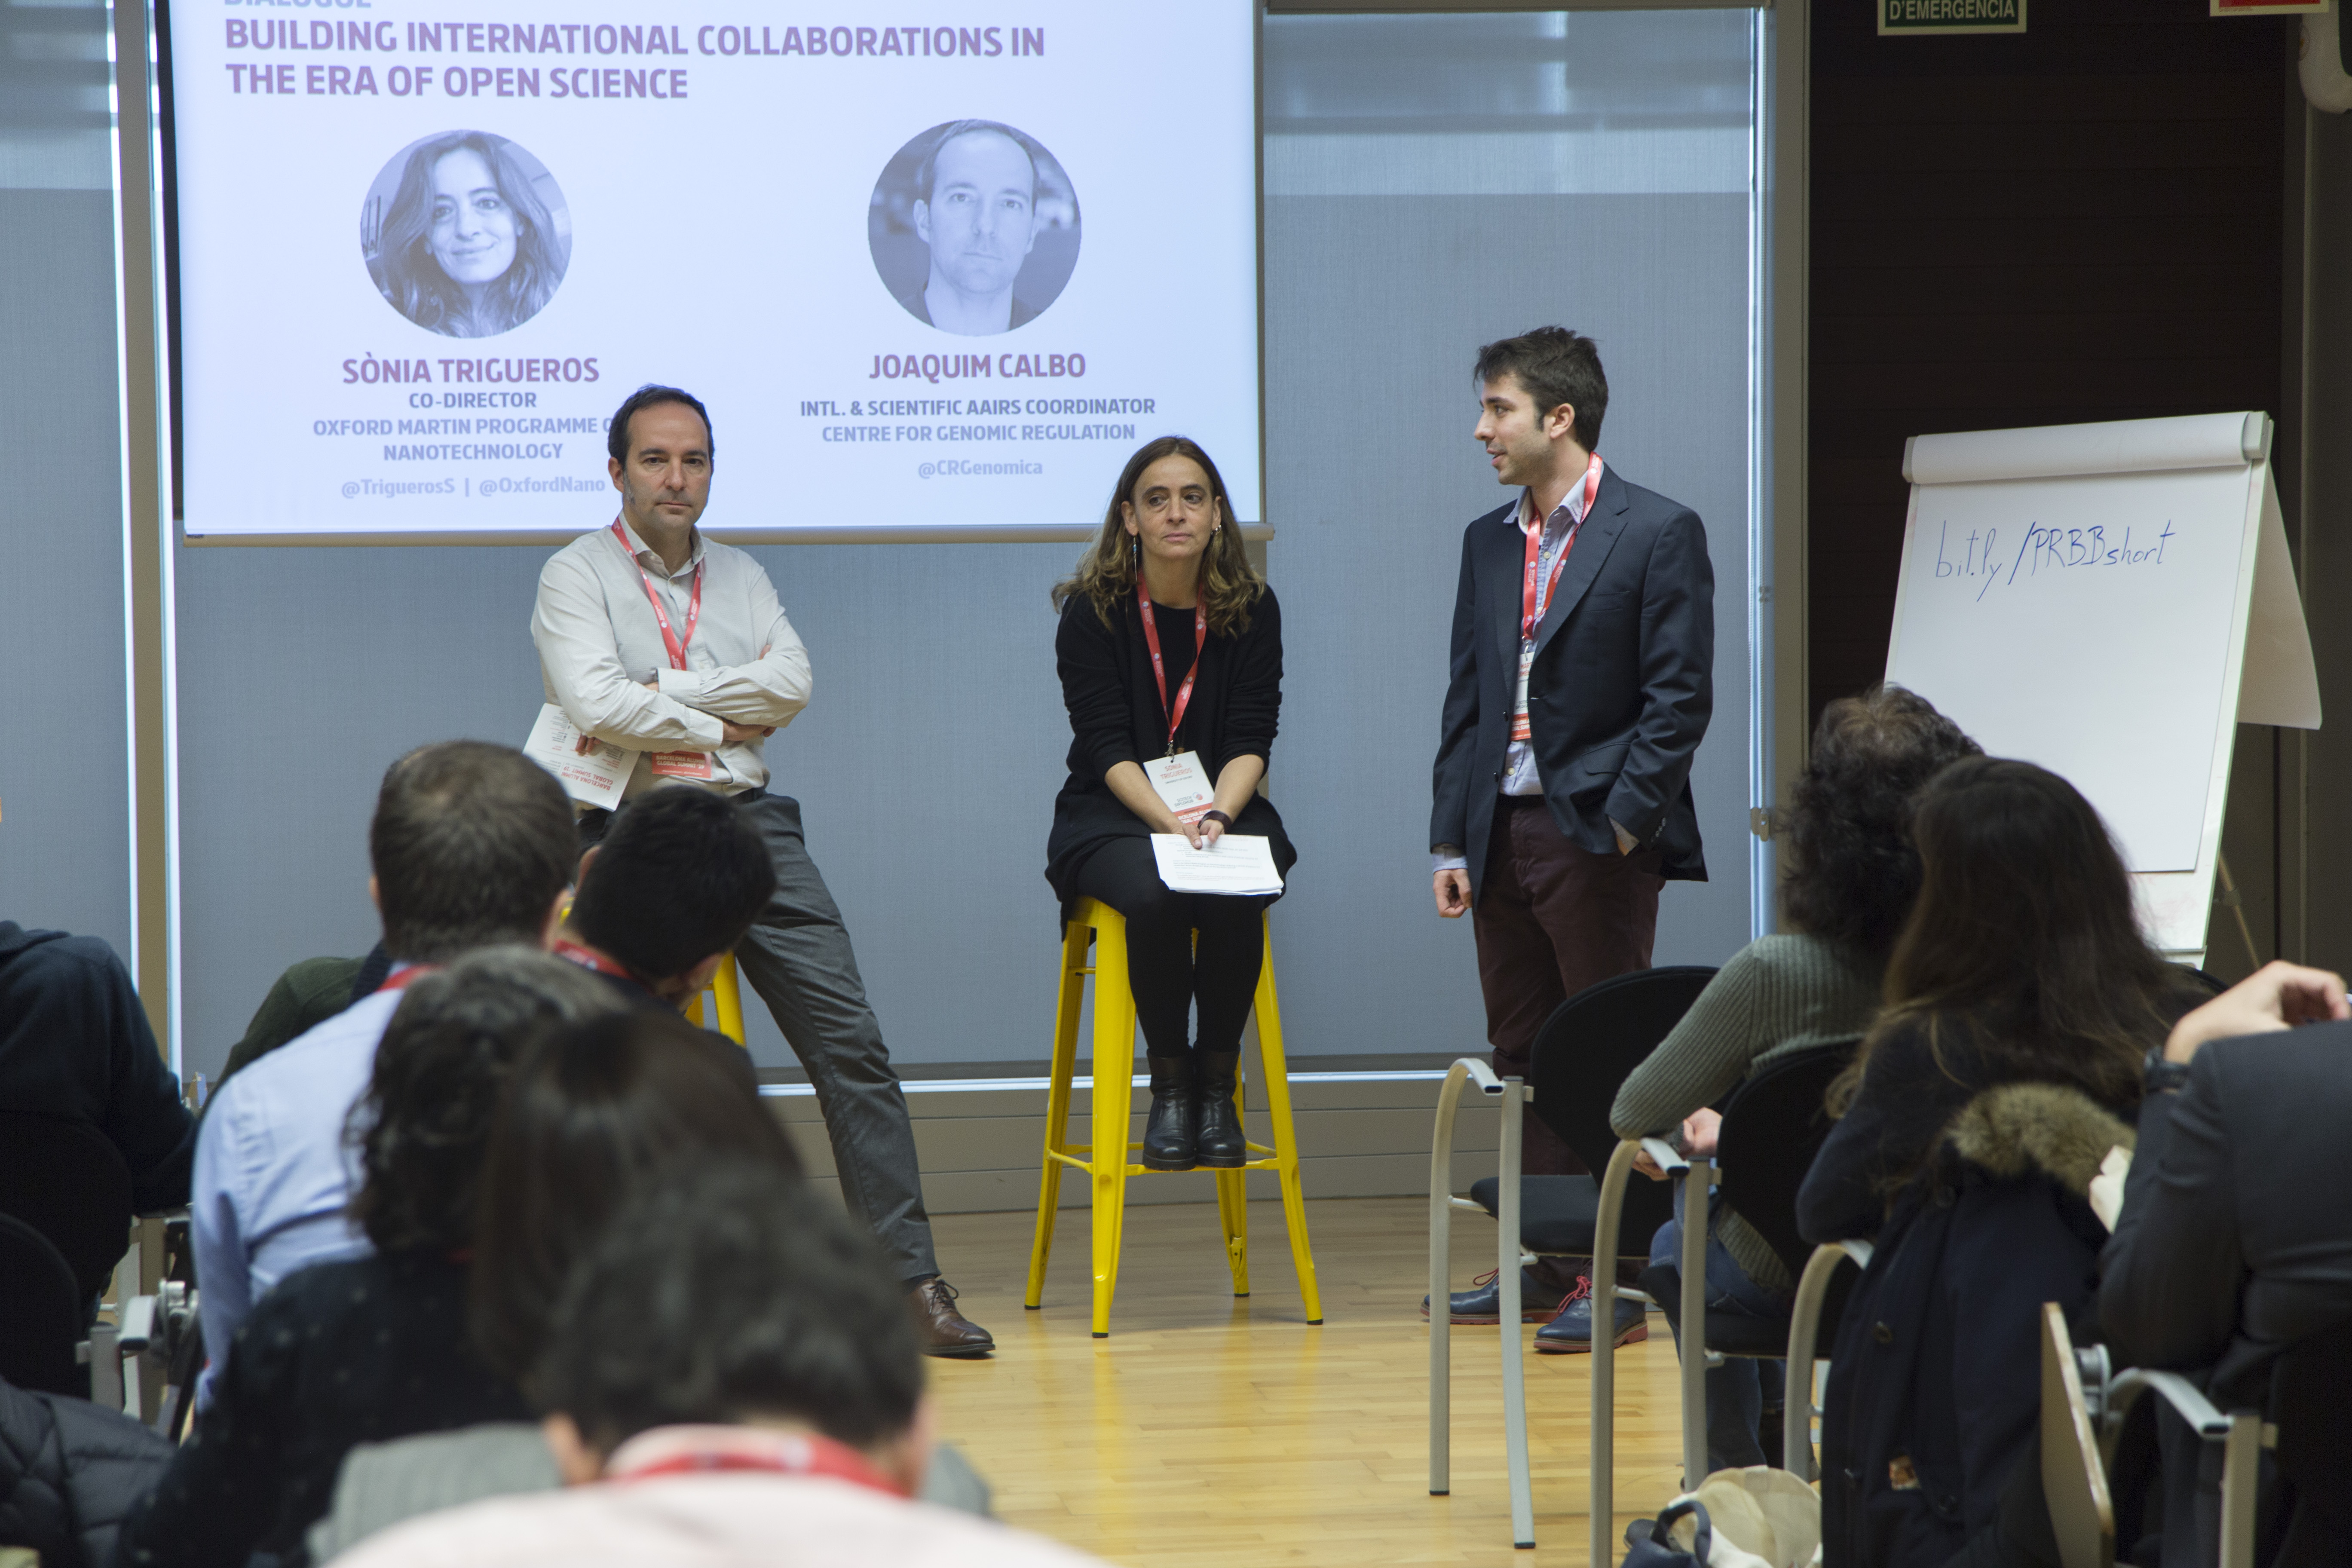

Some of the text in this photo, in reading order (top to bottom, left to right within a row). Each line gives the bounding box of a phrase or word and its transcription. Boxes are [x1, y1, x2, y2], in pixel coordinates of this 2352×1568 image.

[225, 18, 1044, 57] BUILDING INTERNATIONAL COLLABORATIONS IN
[225, 63, 688, 99] THE ERA OF OPEN SCIENCE
[343, 351, 600, 384] SÒNIA TRIGUEROS
[869, 353, 1086, 384] JOAQUIM CALBO
[409, 392, 537, 408] CO-DIRECTOR
[801, 398, 1155, 416] INTL. & SCIENTIFIC AAIRS COORDINATOR
[313, 420, 393, 436] OXFORD
[398, 419, 471, 435] MARTIN
[476, 417, 597, 434] PROGRAMME
[822, 424, 1135, 442] CENTRE FOR GENOMIC REGULATION
[383, 443, 563, 461] NANOTECHNOLOGY
[918, 459, 1043, 479] @CRGenomica
[341, 478, 455, 499] @TriguerosS
[479, 476, 606, 497] @OxfordNano
[571, 768, 592, 778] SUMMIT
[593, 774, 613, 785] GLOBAL
[580, 776, 611, 790] BARCELONA
